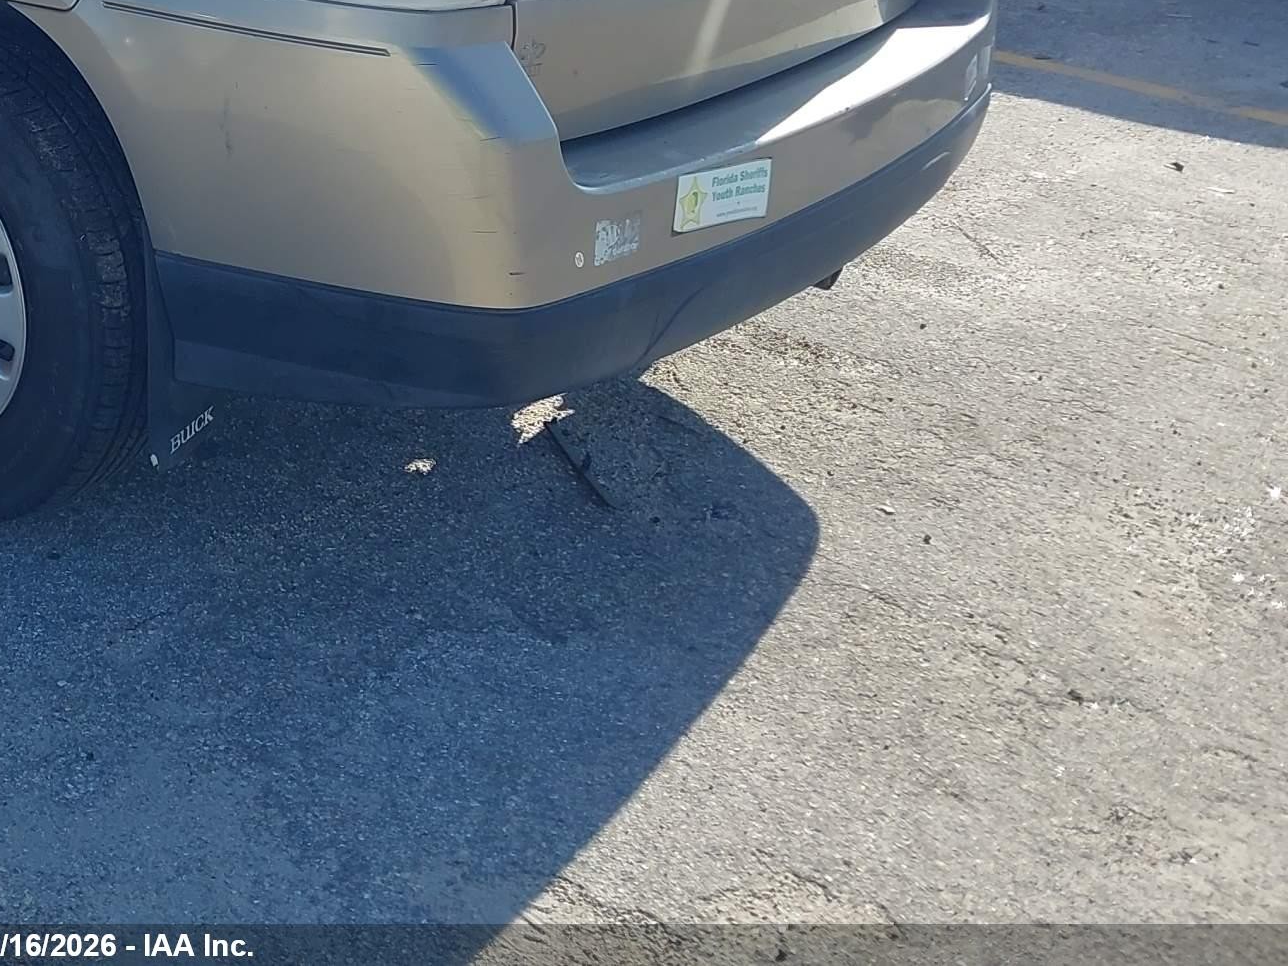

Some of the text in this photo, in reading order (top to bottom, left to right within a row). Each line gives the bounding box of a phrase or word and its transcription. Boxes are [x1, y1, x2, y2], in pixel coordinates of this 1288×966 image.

[711, 172, 739, 188] Florida
[711, 183, 766, 202] Youth Ranches
[170, 405, 214, 454] BUICK
